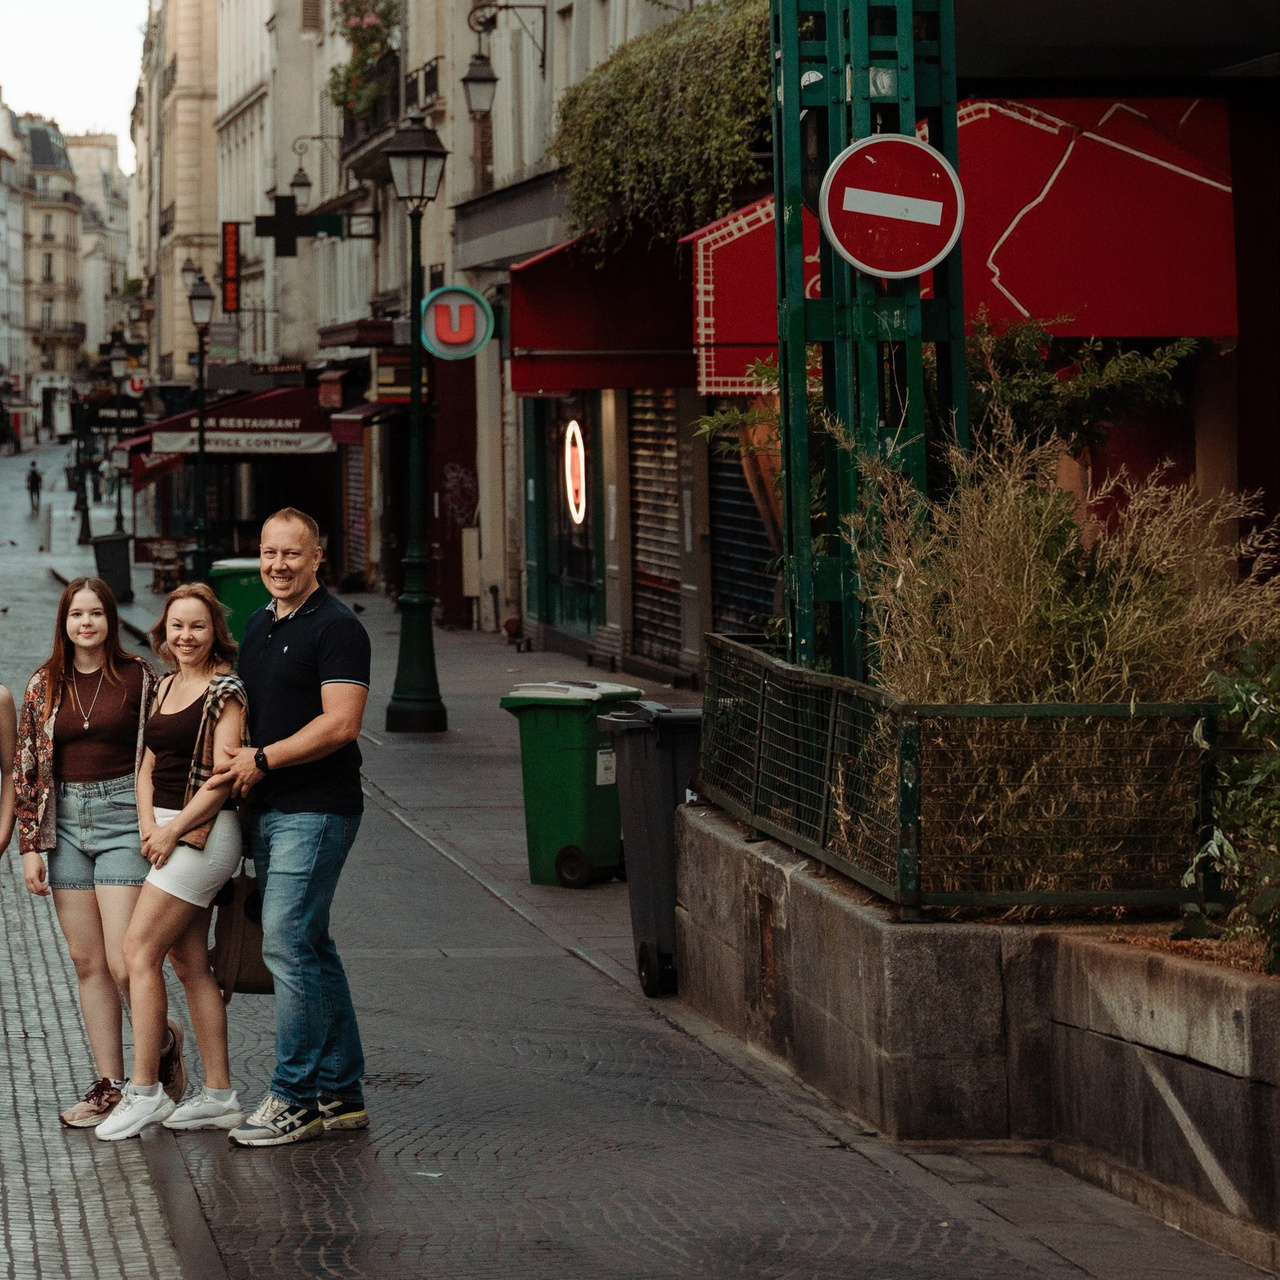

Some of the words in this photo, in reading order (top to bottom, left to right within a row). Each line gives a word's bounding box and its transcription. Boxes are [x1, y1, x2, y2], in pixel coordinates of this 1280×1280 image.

[434, 304, 476, 344] U
[130, 377, 144, 393] U
[219, 417, 301, 429] RESTAURANT
[189, 438, 240, 447] SRVICE
